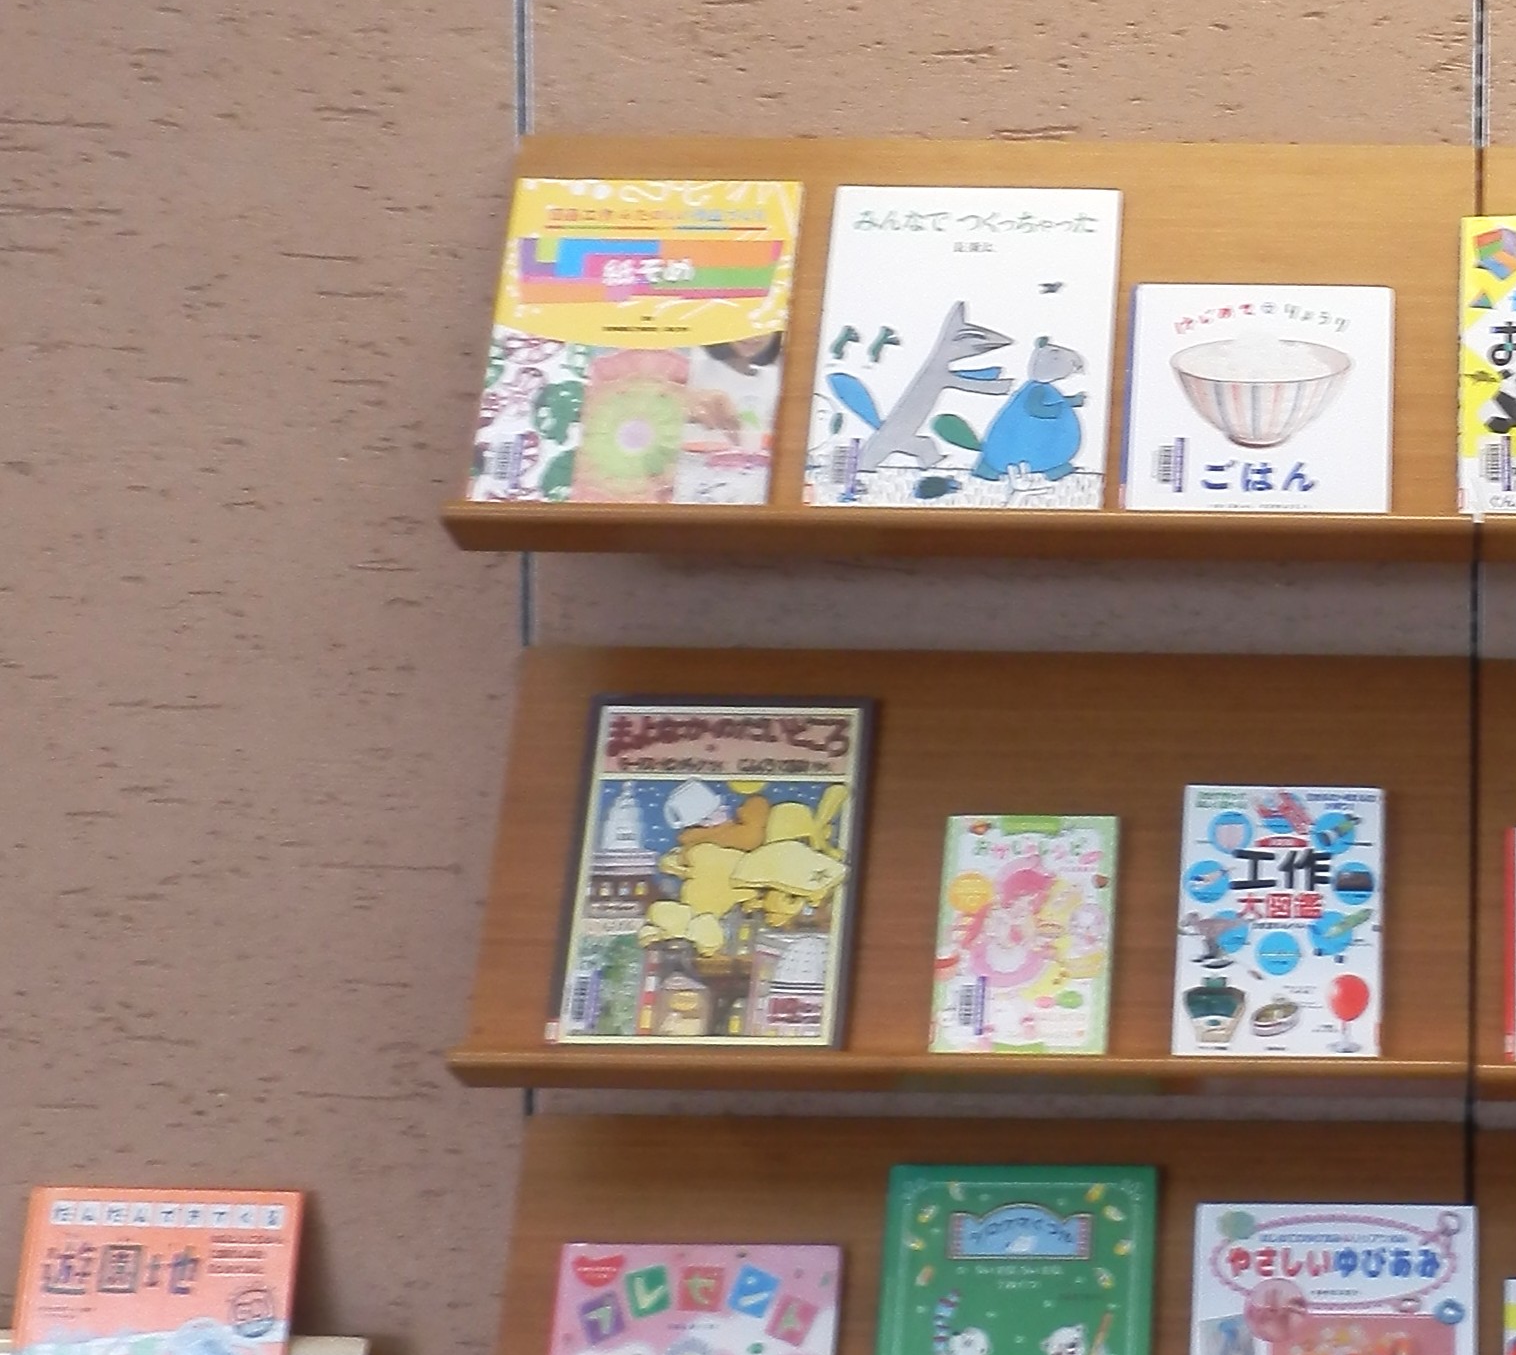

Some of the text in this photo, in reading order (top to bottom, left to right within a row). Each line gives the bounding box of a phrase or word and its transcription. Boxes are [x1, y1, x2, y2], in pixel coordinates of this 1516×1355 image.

[1202, 459, 1316, 492] ごはん
[1229, 848, 1332, 891] 工作
[42, 1241, 200, 1295] 遊園地
